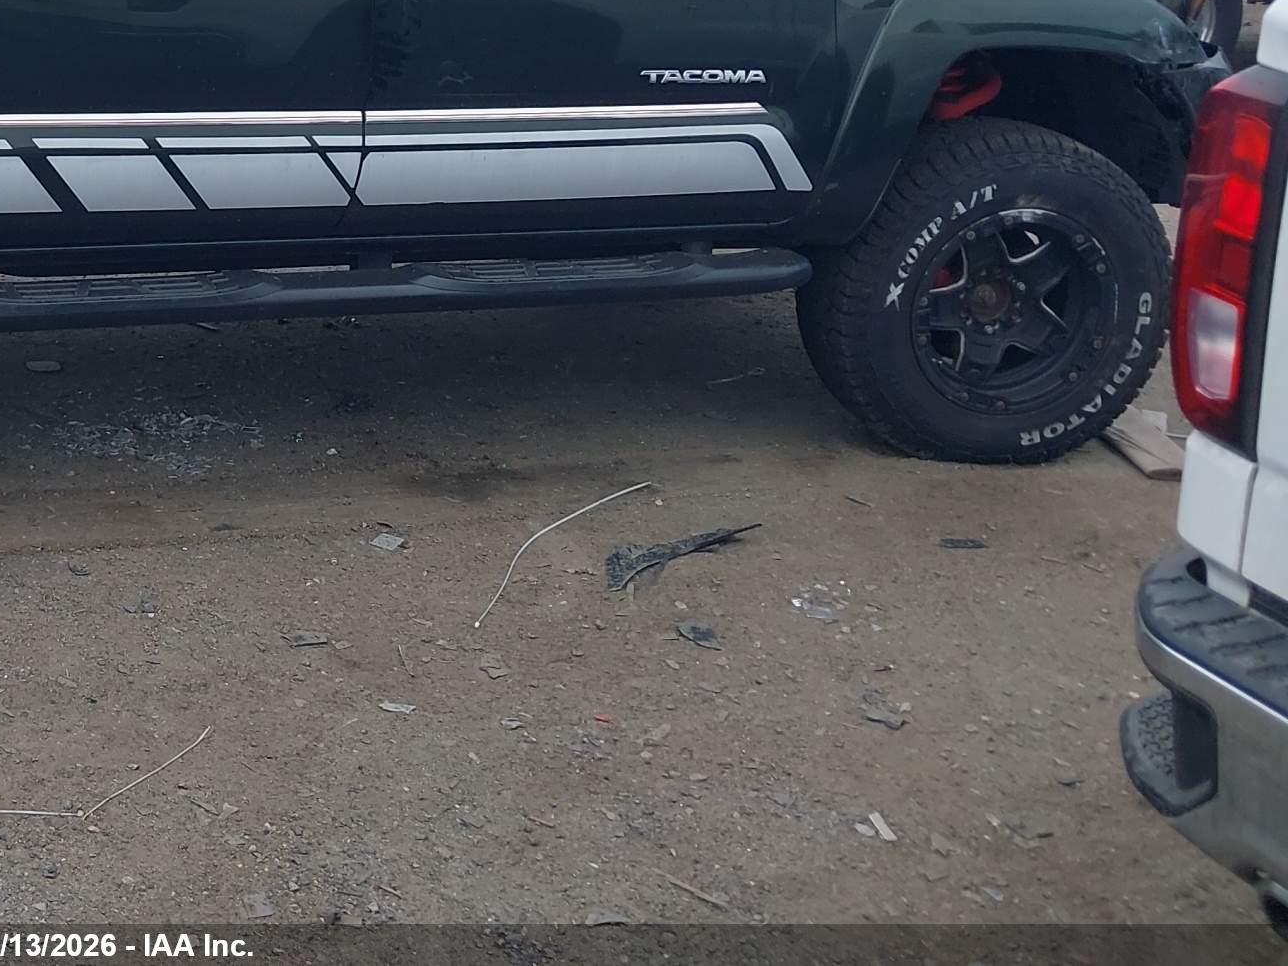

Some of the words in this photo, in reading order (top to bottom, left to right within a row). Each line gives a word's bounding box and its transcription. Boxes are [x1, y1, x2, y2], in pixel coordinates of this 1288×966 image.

[640, 69, 767, 84] TACOMA
[884, 282, 905, 312] X
[898, 216, 943, 279] COMP
[951, 184, 997, 220] A/T
[1019, 291, 1152, 446] GLADIATOR
